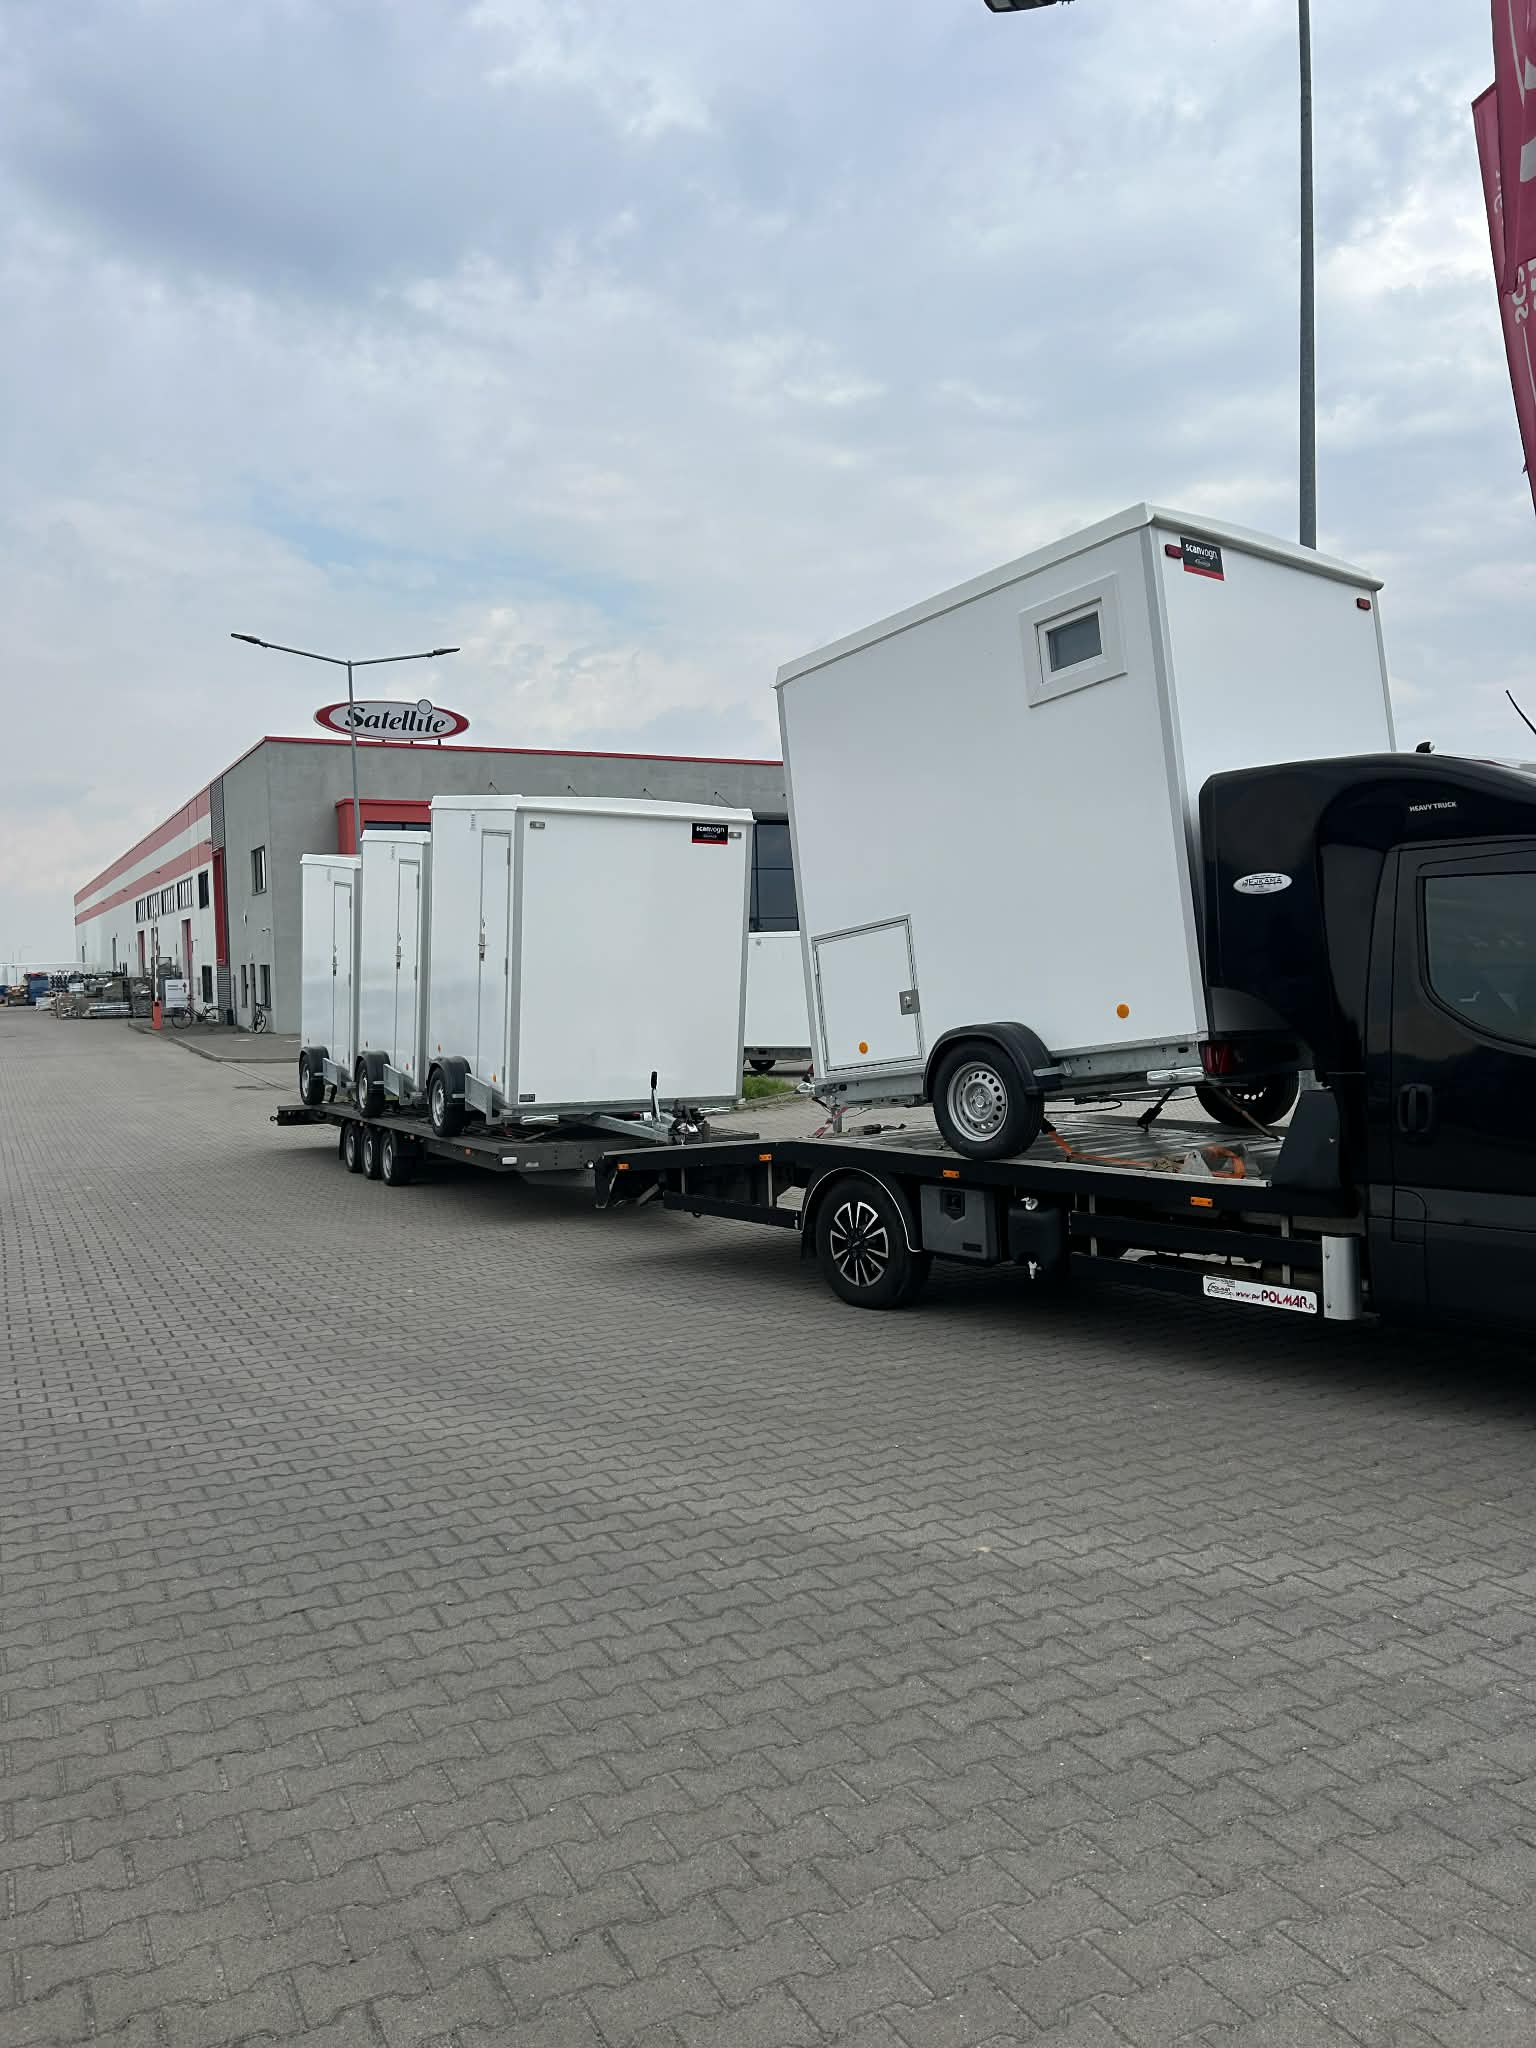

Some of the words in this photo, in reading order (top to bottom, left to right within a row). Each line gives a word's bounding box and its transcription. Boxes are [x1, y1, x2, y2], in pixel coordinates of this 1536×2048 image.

[344, 706, 446, 733] Satellite
[1409, 803, 1432, 812] HEAVY
[1432, 801, 1457, 809] TRUCK
